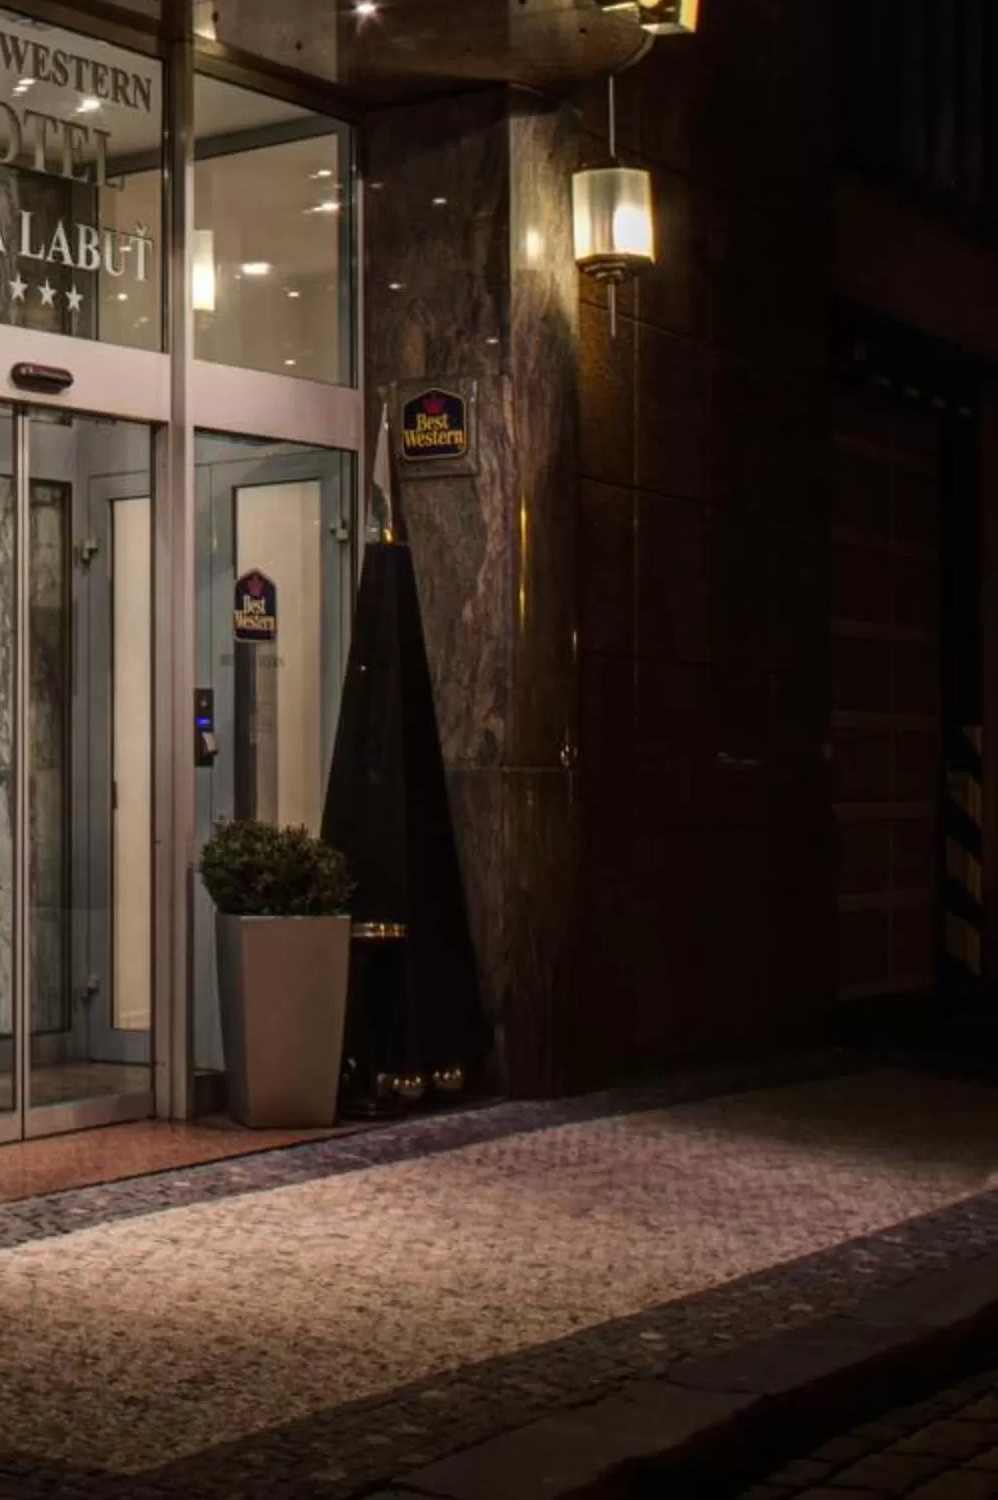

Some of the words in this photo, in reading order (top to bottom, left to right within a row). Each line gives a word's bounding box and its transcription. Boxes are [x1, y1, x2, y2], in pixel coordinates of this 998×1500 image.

[17, 209, 154, 282] LABUŤ
[416, 412, 450, 431] Best
[403, 429, 466, 449] Western
